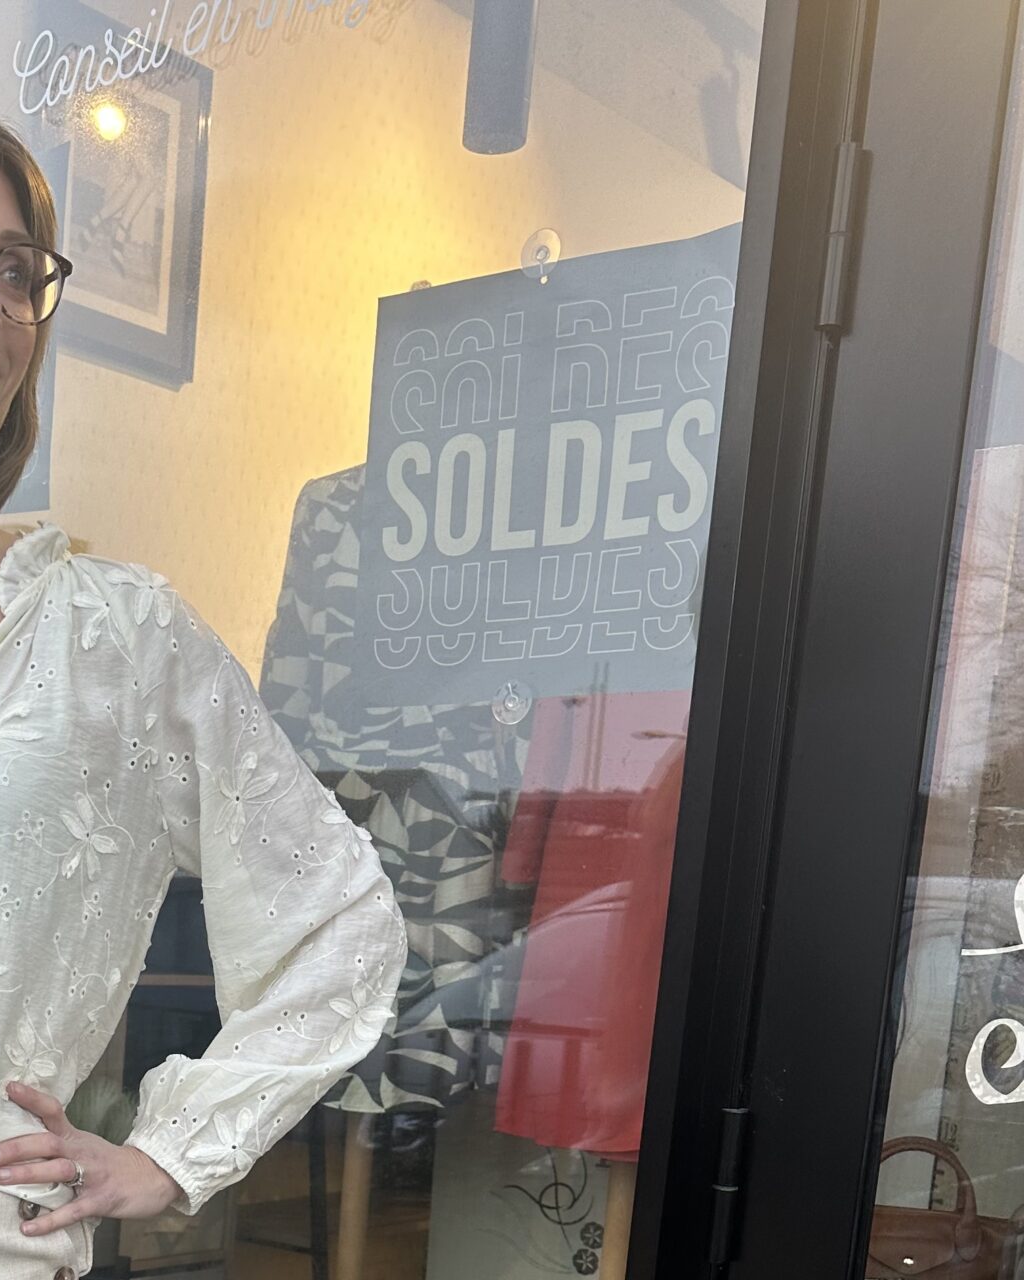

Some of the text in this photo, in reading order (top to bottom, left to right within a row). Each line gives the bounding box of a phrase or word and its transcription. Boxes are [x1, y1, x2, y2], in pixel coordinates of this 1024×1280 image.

[12, 0, 242, 115] Conseil en
[381, 398, 716, 562] SOLDES
